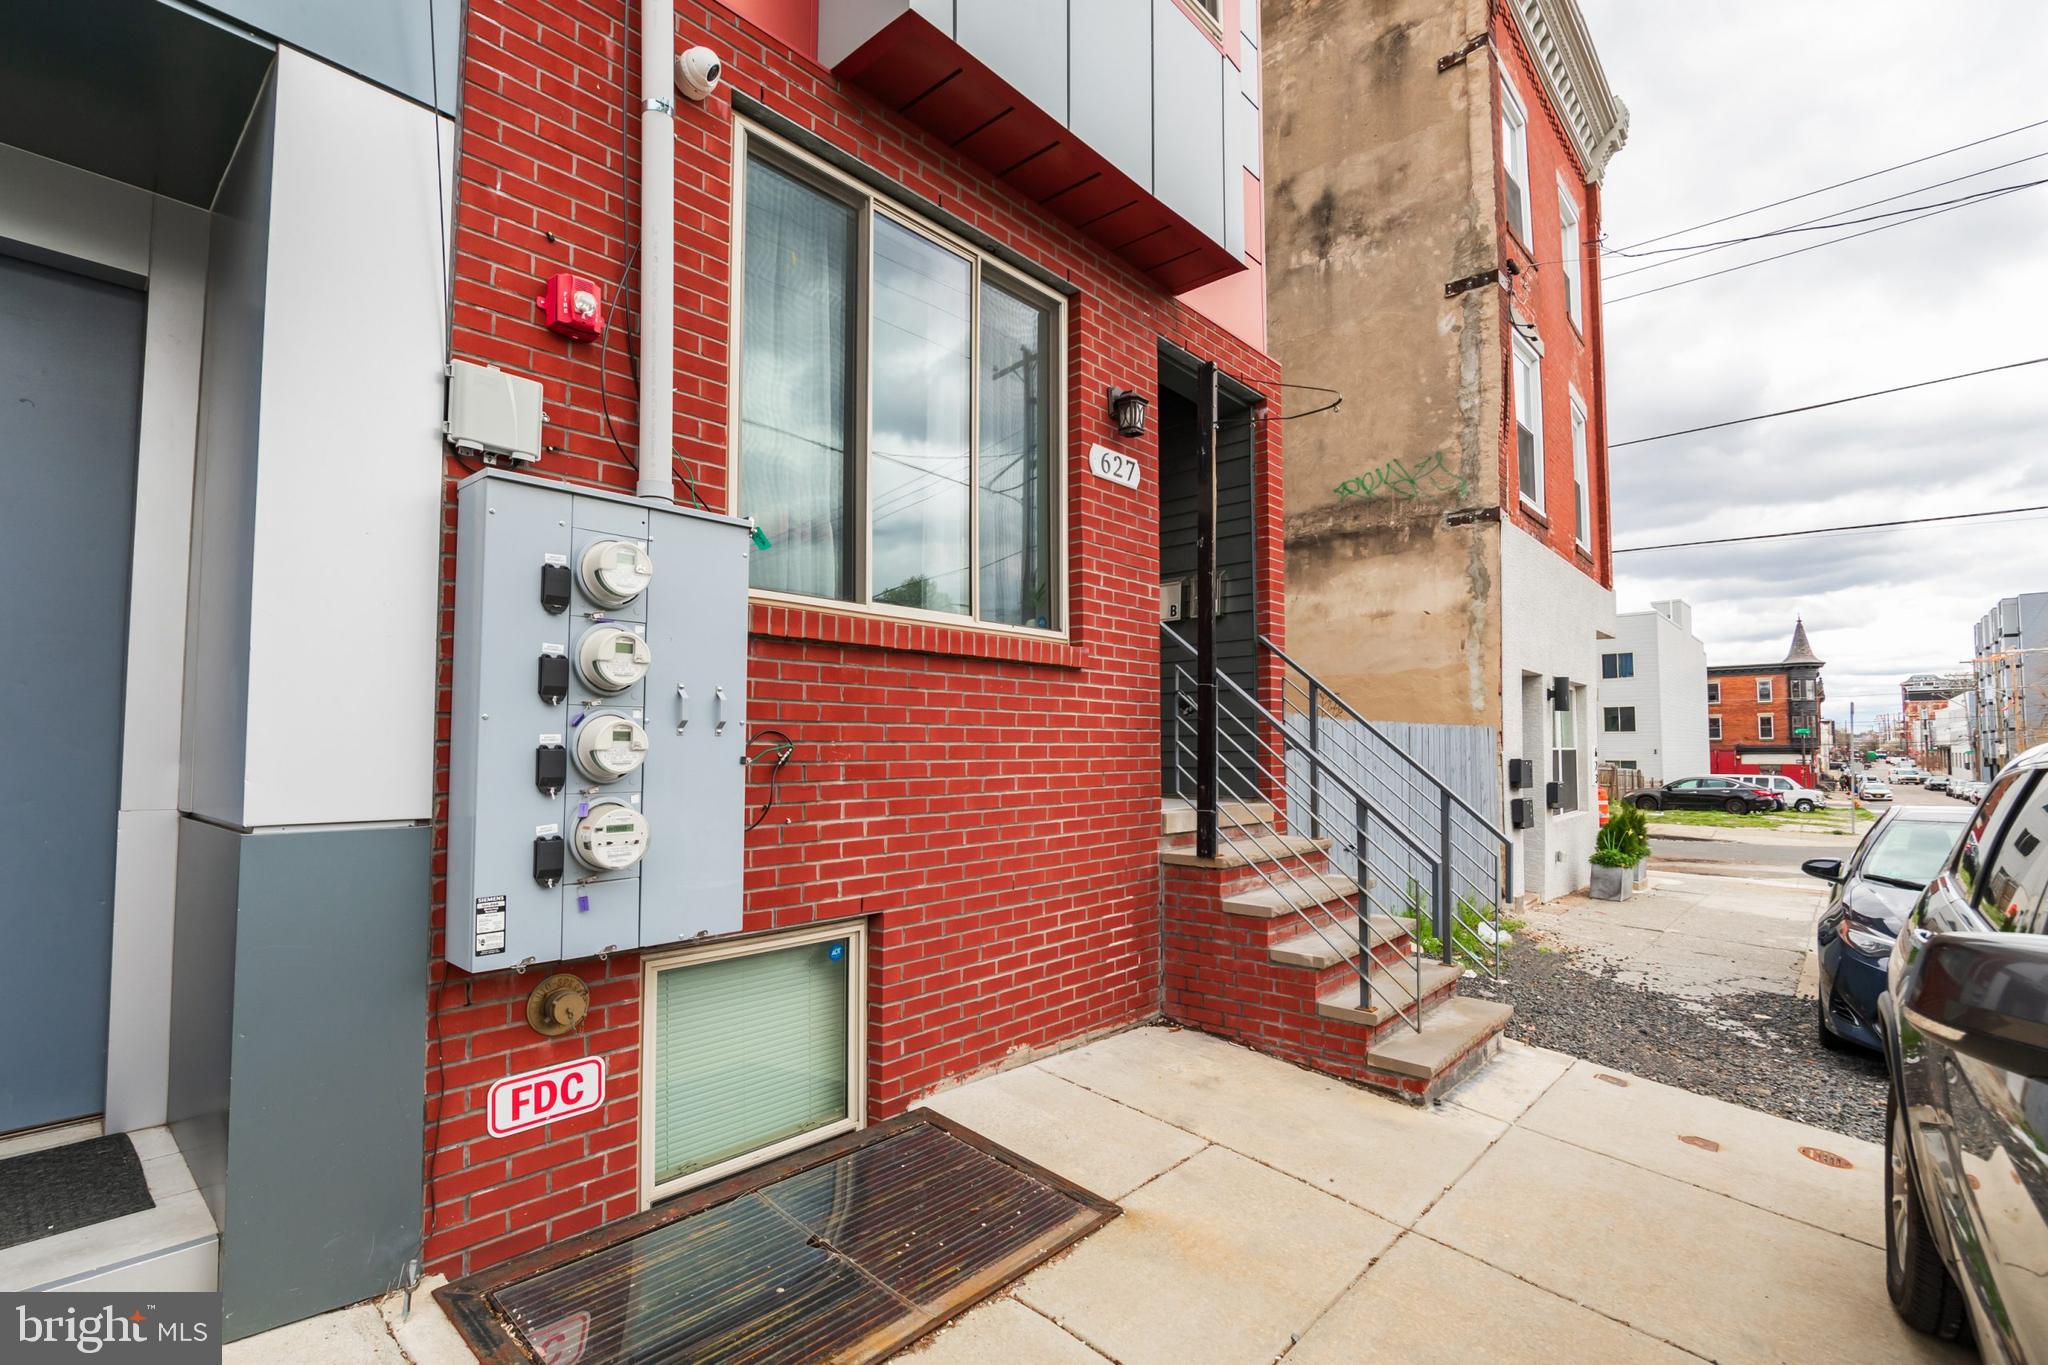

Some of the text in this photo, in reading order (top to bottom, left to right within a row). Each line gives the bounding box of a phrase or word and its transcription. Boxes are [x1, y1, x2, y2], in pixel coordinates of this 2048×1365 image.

[1101, 453, 1136, 481] 627
[1170, 604, 1177, 617] B
[478, 895, 505, 904] SIEMENS
[512, 1072, 584, 1121] FDC
